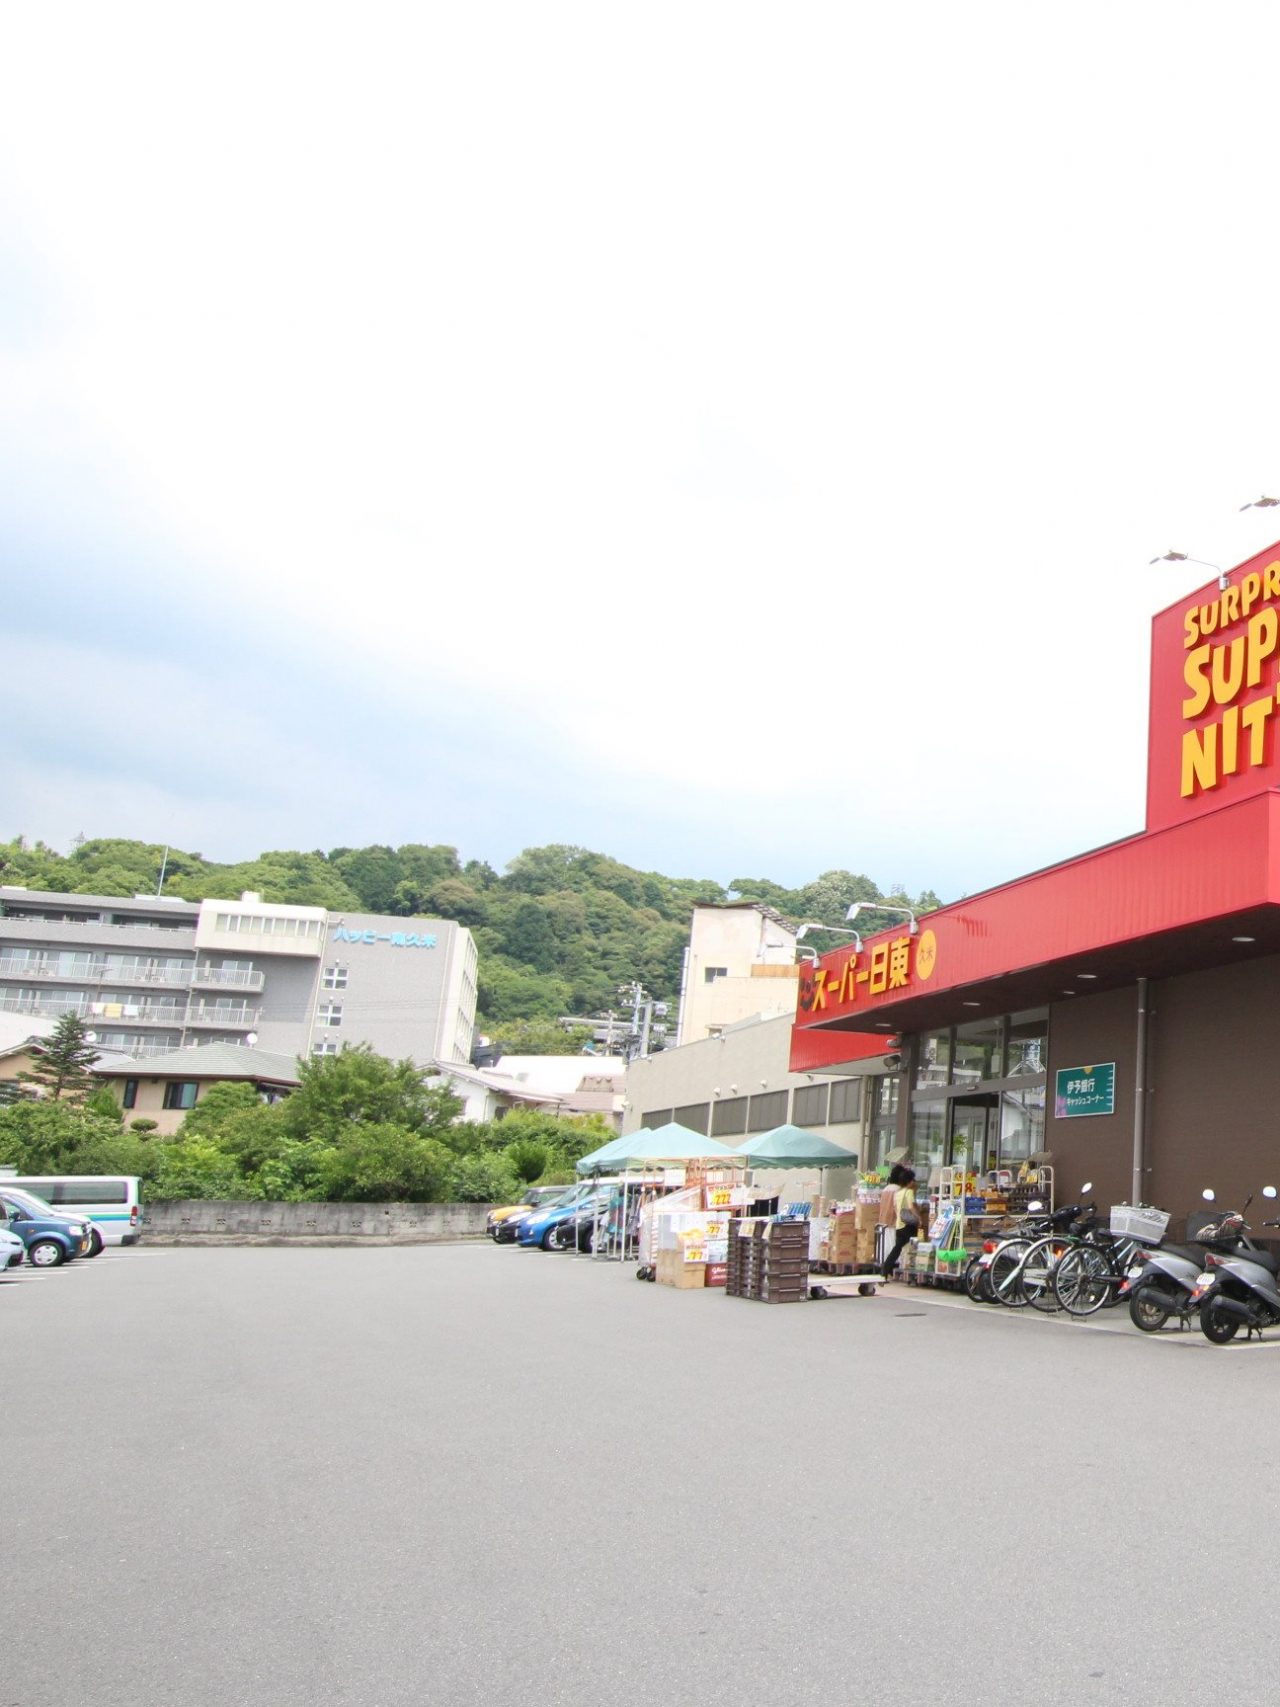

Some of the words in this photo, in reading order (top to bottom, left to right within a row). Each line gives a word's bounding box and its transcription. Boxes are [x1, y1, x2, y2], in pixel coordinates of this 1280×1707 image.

[811, 936, 912, 1013] スーパー日東
